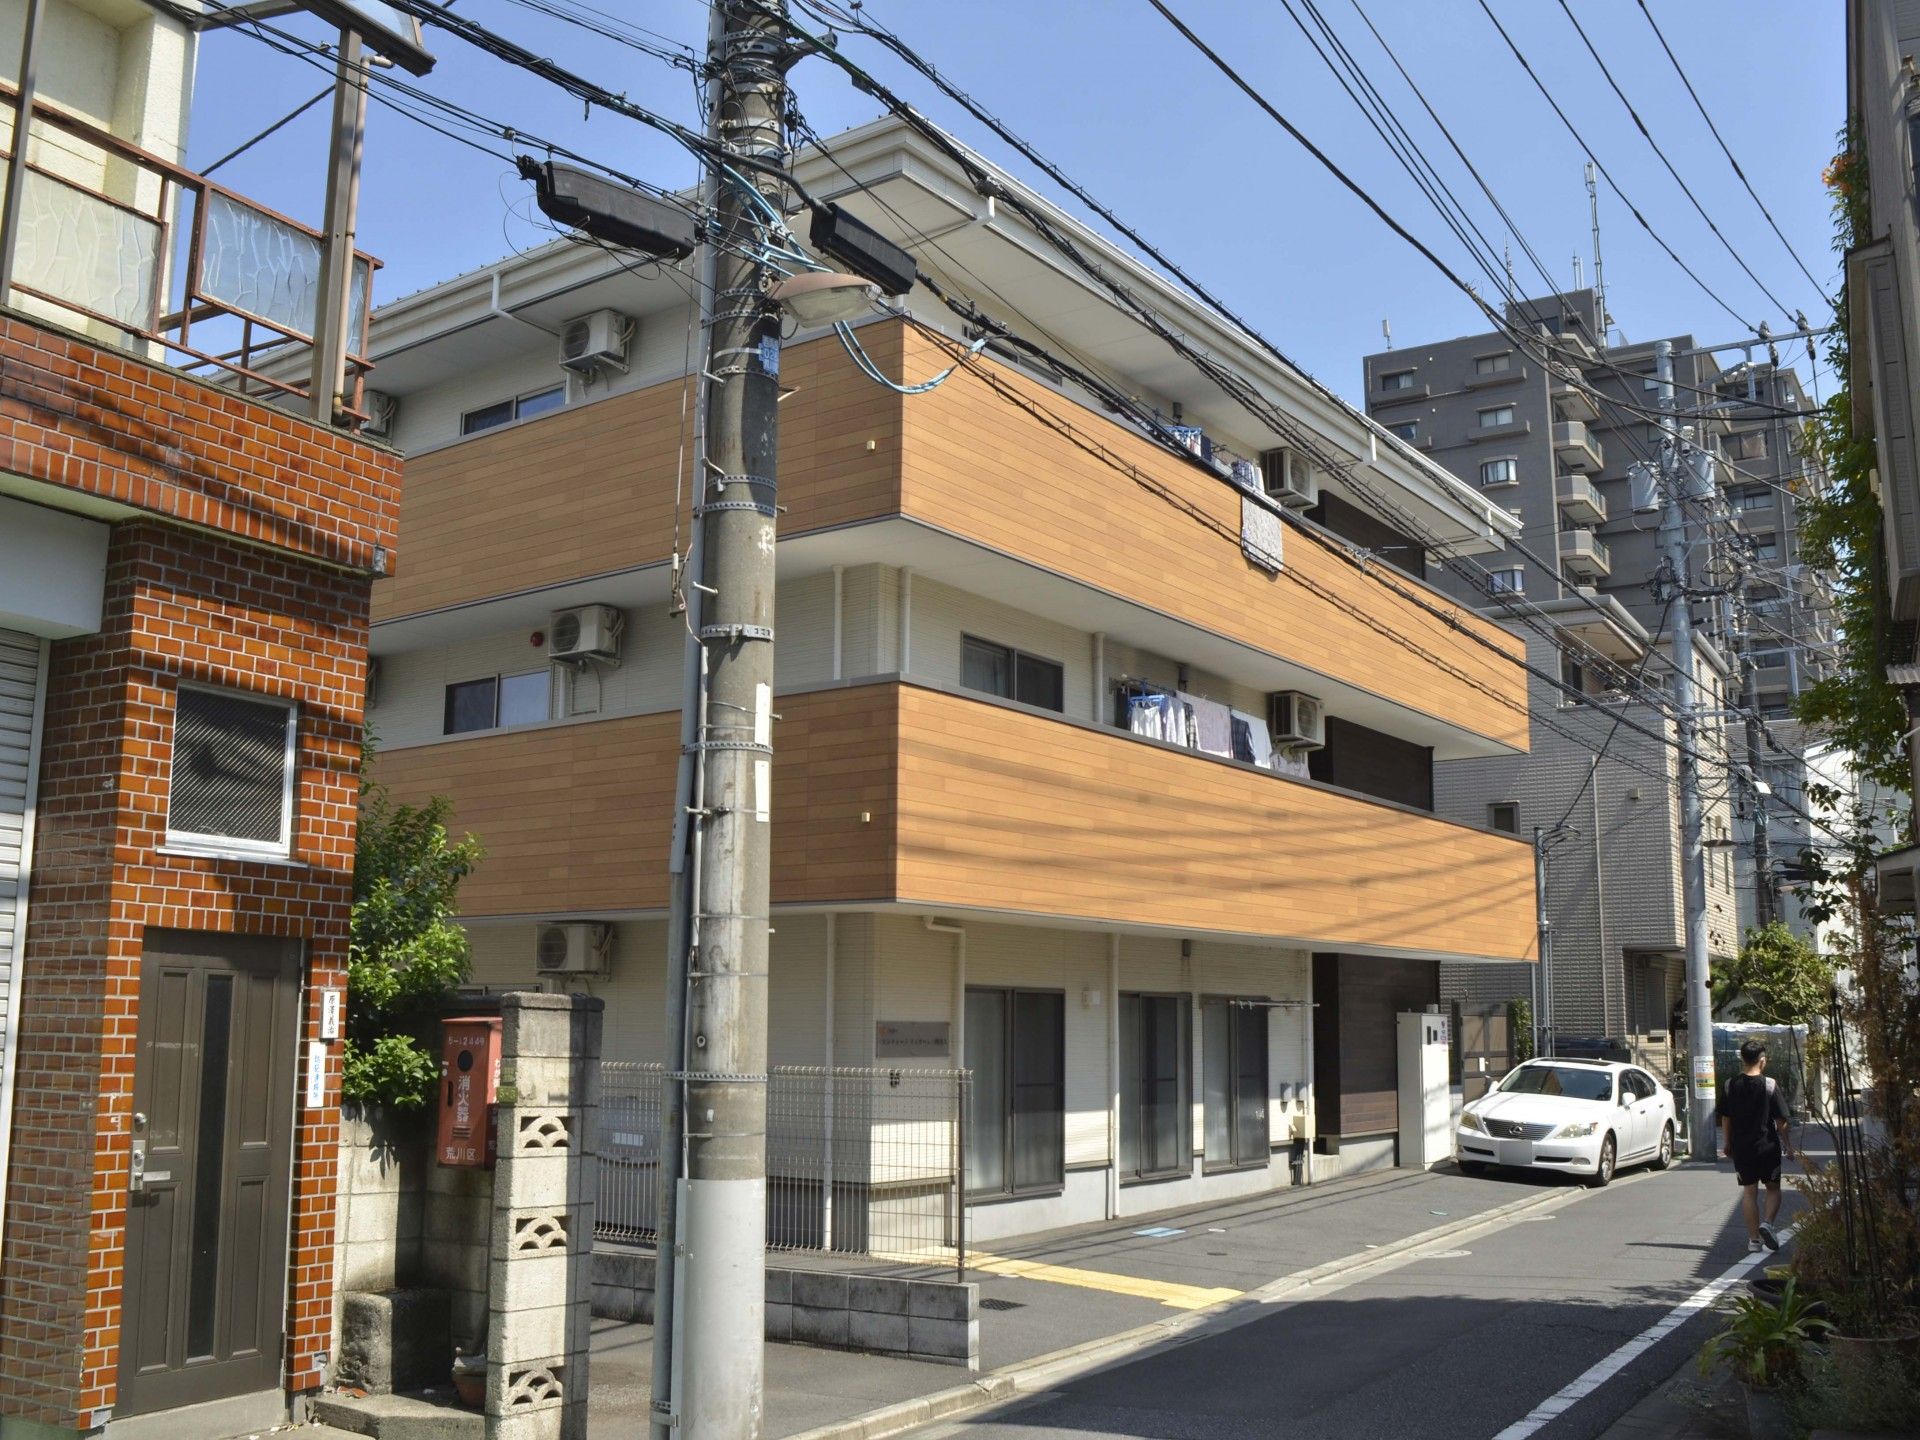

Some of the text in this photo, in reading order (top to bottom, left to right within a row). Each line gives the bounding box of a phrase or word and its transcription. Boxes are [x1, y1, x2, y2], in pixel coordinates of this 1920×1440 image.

[457, 1075, 471, 1123] 消火器
[445, 1146, 477, 1161] 荒川区
